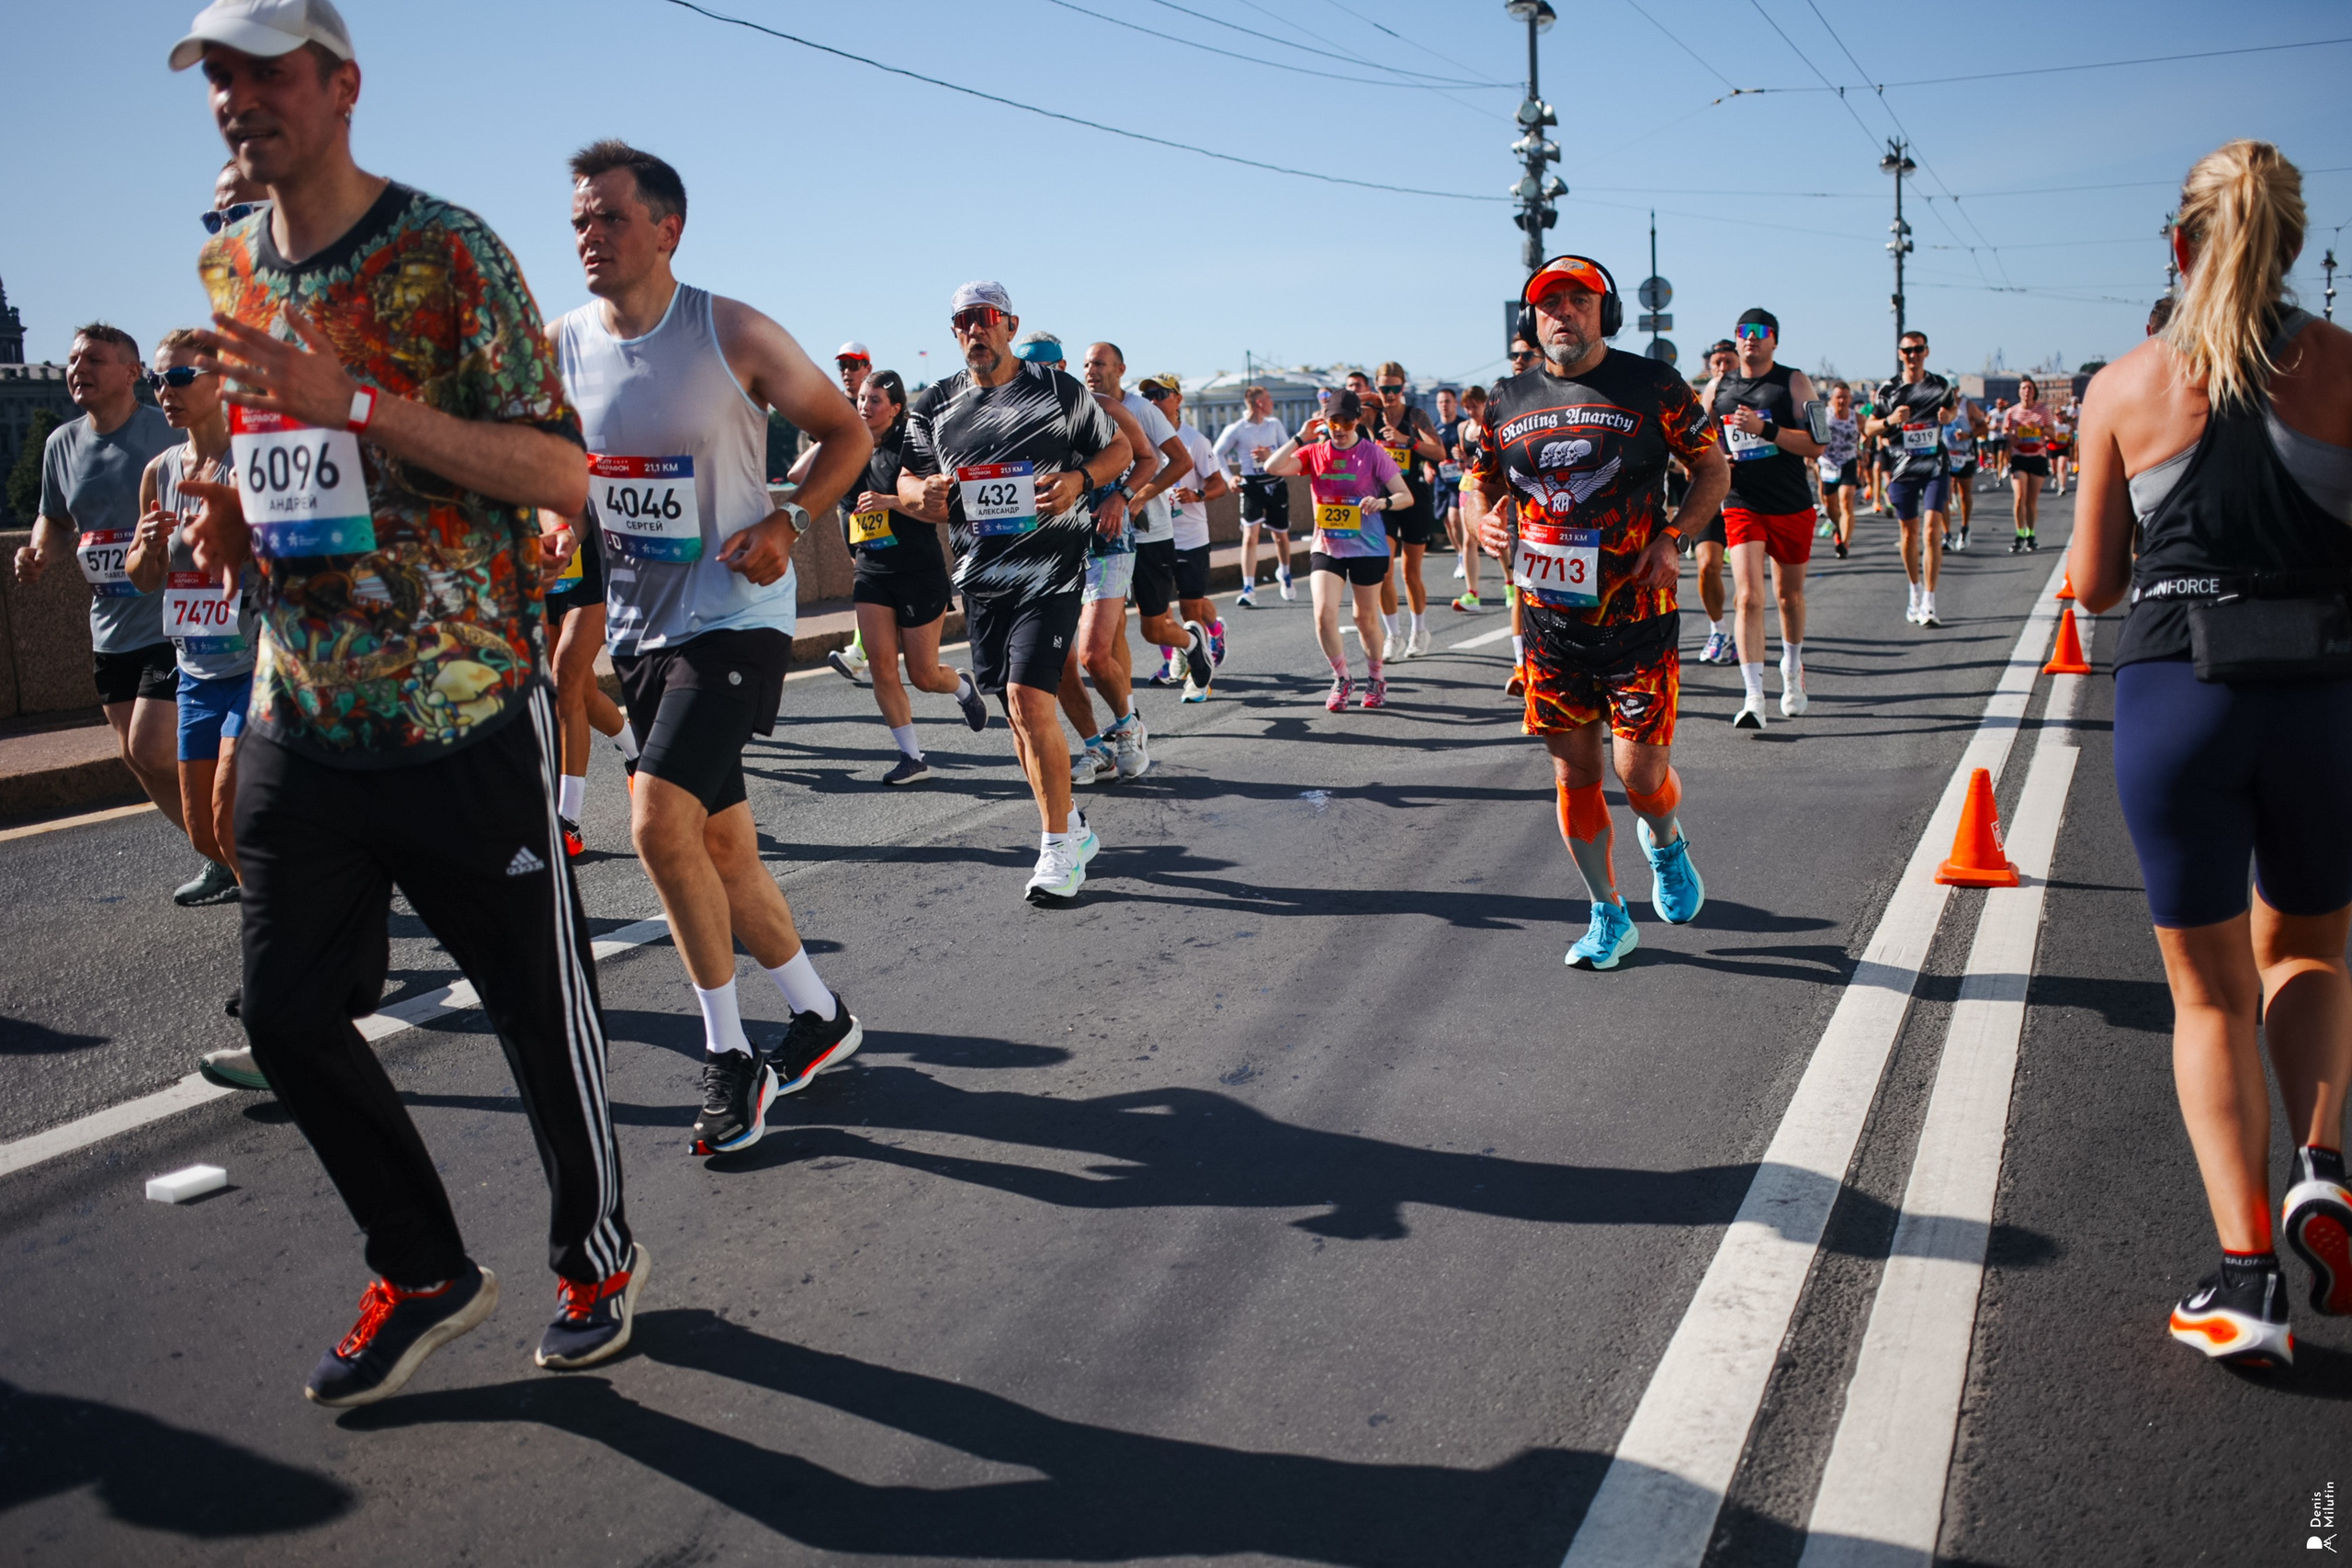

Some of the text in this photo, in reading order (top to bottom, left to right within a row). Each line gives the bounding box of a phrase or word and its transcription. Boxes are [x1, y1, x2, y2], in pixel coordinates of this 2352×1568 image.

[1502, 408, 1634, 443] Rolling Anarchy
[1908, 431, 1934, 443] 4319
[249, 442, 340, 493] 6096
[644, 463, 660, 473] 21,1
[270, 495, 318, 512] АНДРЕЙ
[606, 486, 682, 520] 4046
[978, 483, 1018, 506] 432
[978, 506, 1020, 515] АЛЕКСАНДР
[1325, 508, 1351, 522] 239
[626, 520, 663, 531] СЕРГЕЙ
[855, 513, 884, 533] 1429
[972, 522, 979, 534] E
[86, 547, 129, 571] 572
[1523, 552, 1585, 584] 7713
[174, 600, 230, 626] 7470
